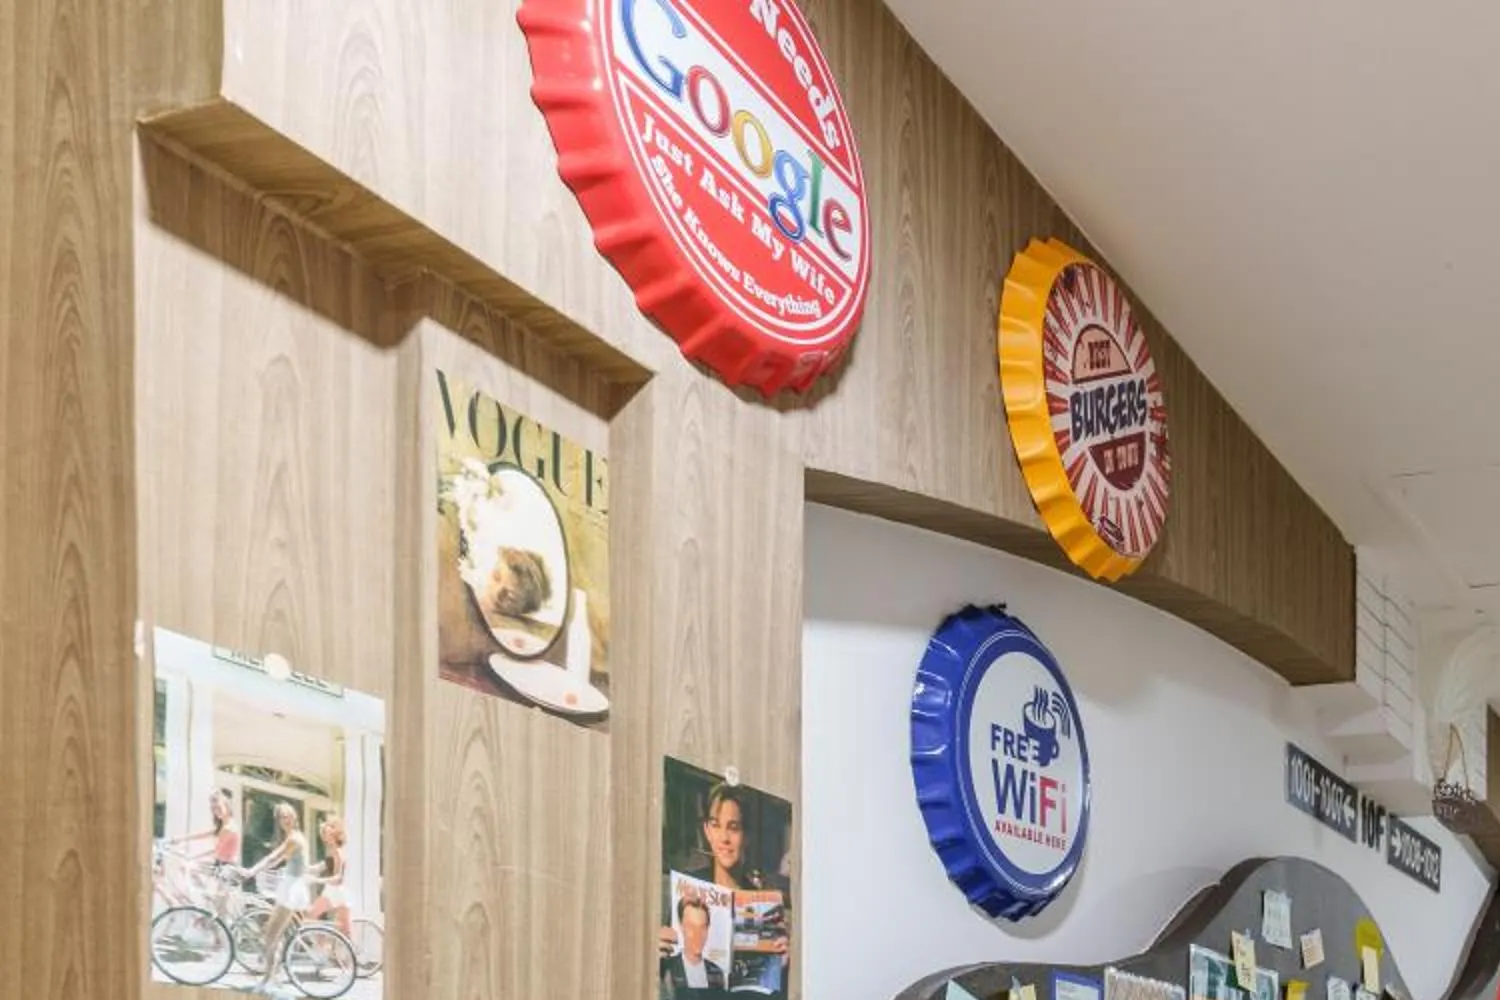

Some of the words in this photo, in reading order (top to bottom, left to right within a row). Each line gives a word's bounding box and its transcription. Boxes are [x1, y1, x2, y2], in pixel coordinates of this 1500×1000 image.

[621, 0, 853, 262] Google
[749, 0, 841, 150] Needs
[642, 112, 694, 177] Just
[699, 167, 745, 224] Ask
[751, 211, 784, 261] My
[789, 247, 835, 305] Wife
[651, 154, 683, 209] She
[683, 207, 741, 283] Knows
[743, 271, 822, 319] Everything
[435, 367, 608, 515] VOGUE
[1070, 378, 1148, 443] BURGERS
[991, 757, 1067, 834] WiFi
[995, 819, 1043, 845] AVAILABLE
